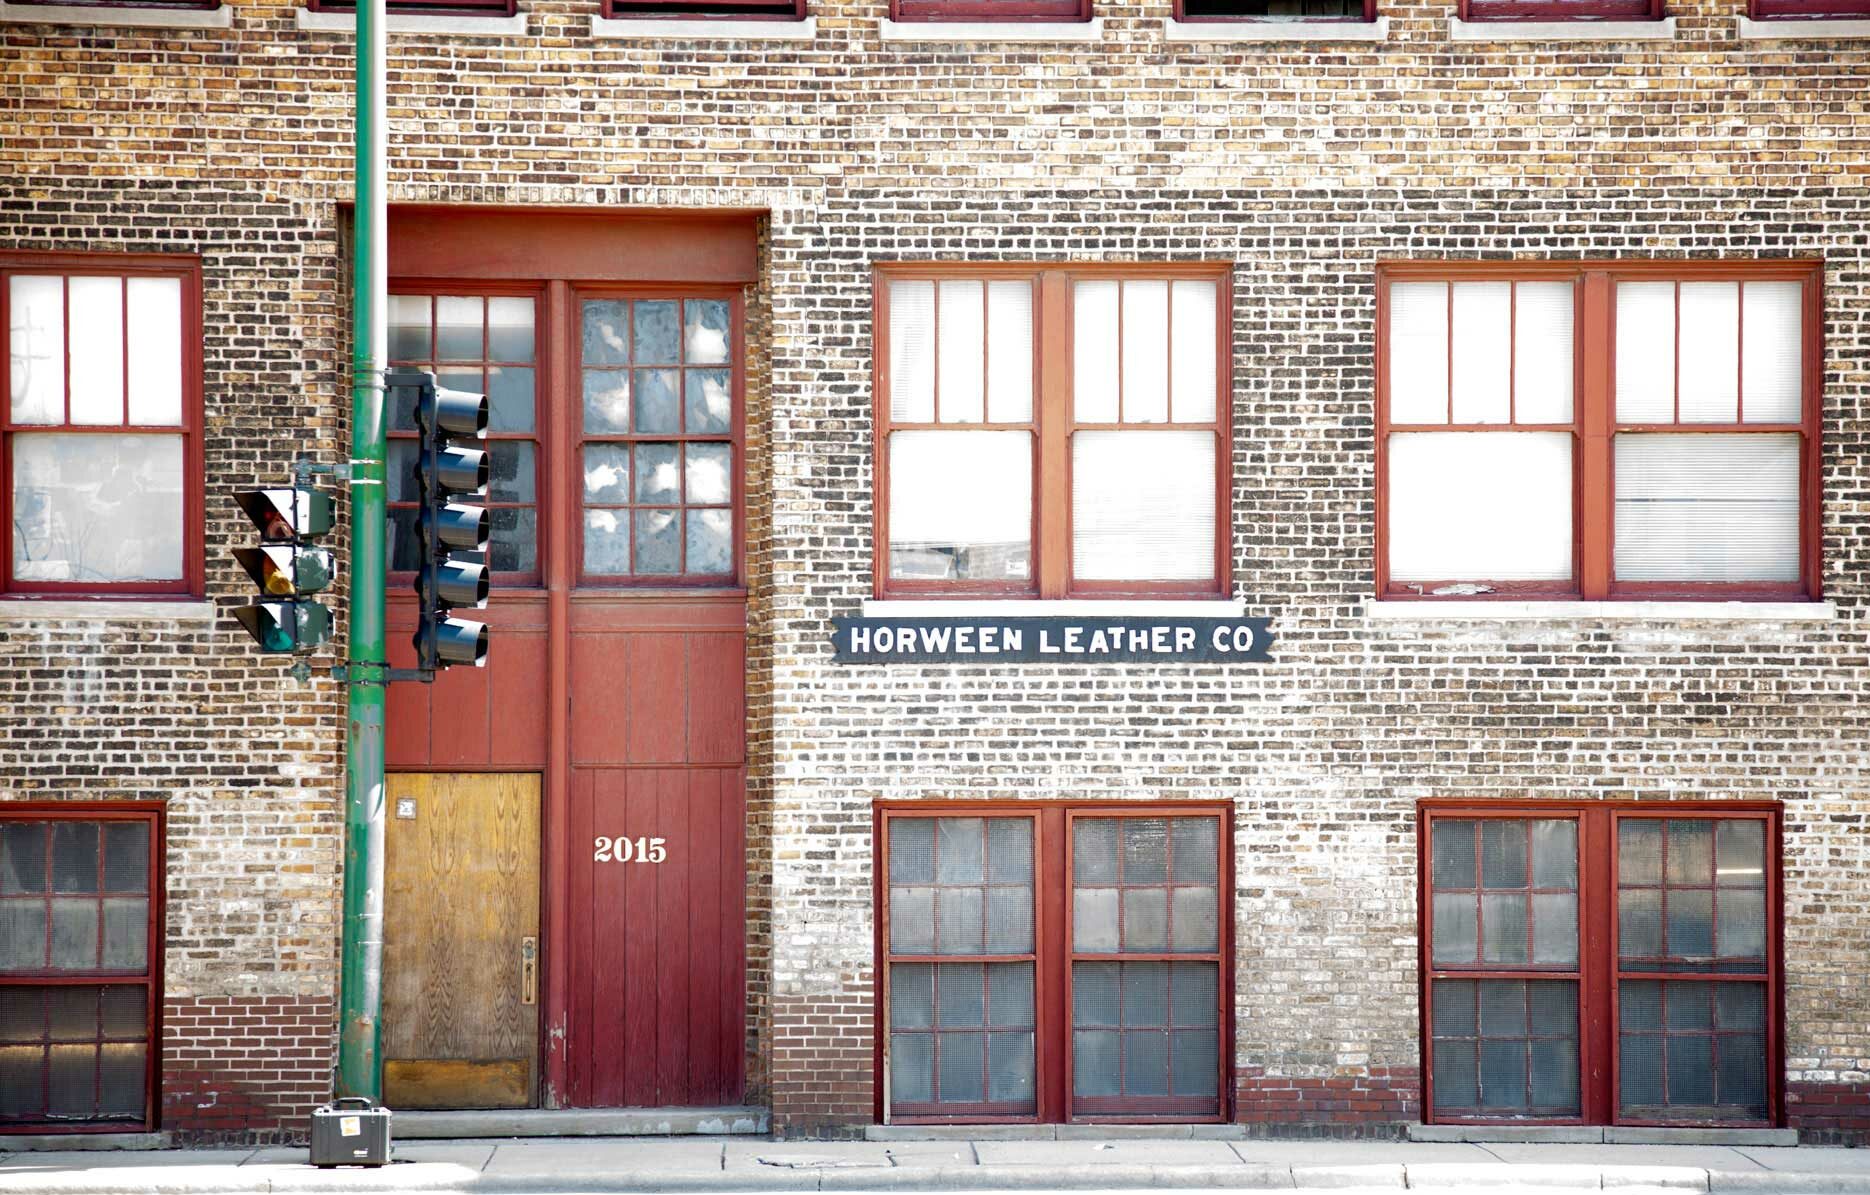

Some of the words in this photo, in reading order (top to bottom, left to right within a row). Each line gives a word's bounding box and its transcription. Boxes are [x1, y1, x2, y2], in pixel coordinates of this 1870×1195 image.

[850, 626, 1023, 654] HORWEEN
[1039, 626, 1196, 654] LEATHER
[1212, 625, 1254, 653] CO
[594, 836, 667, 864] 2015
